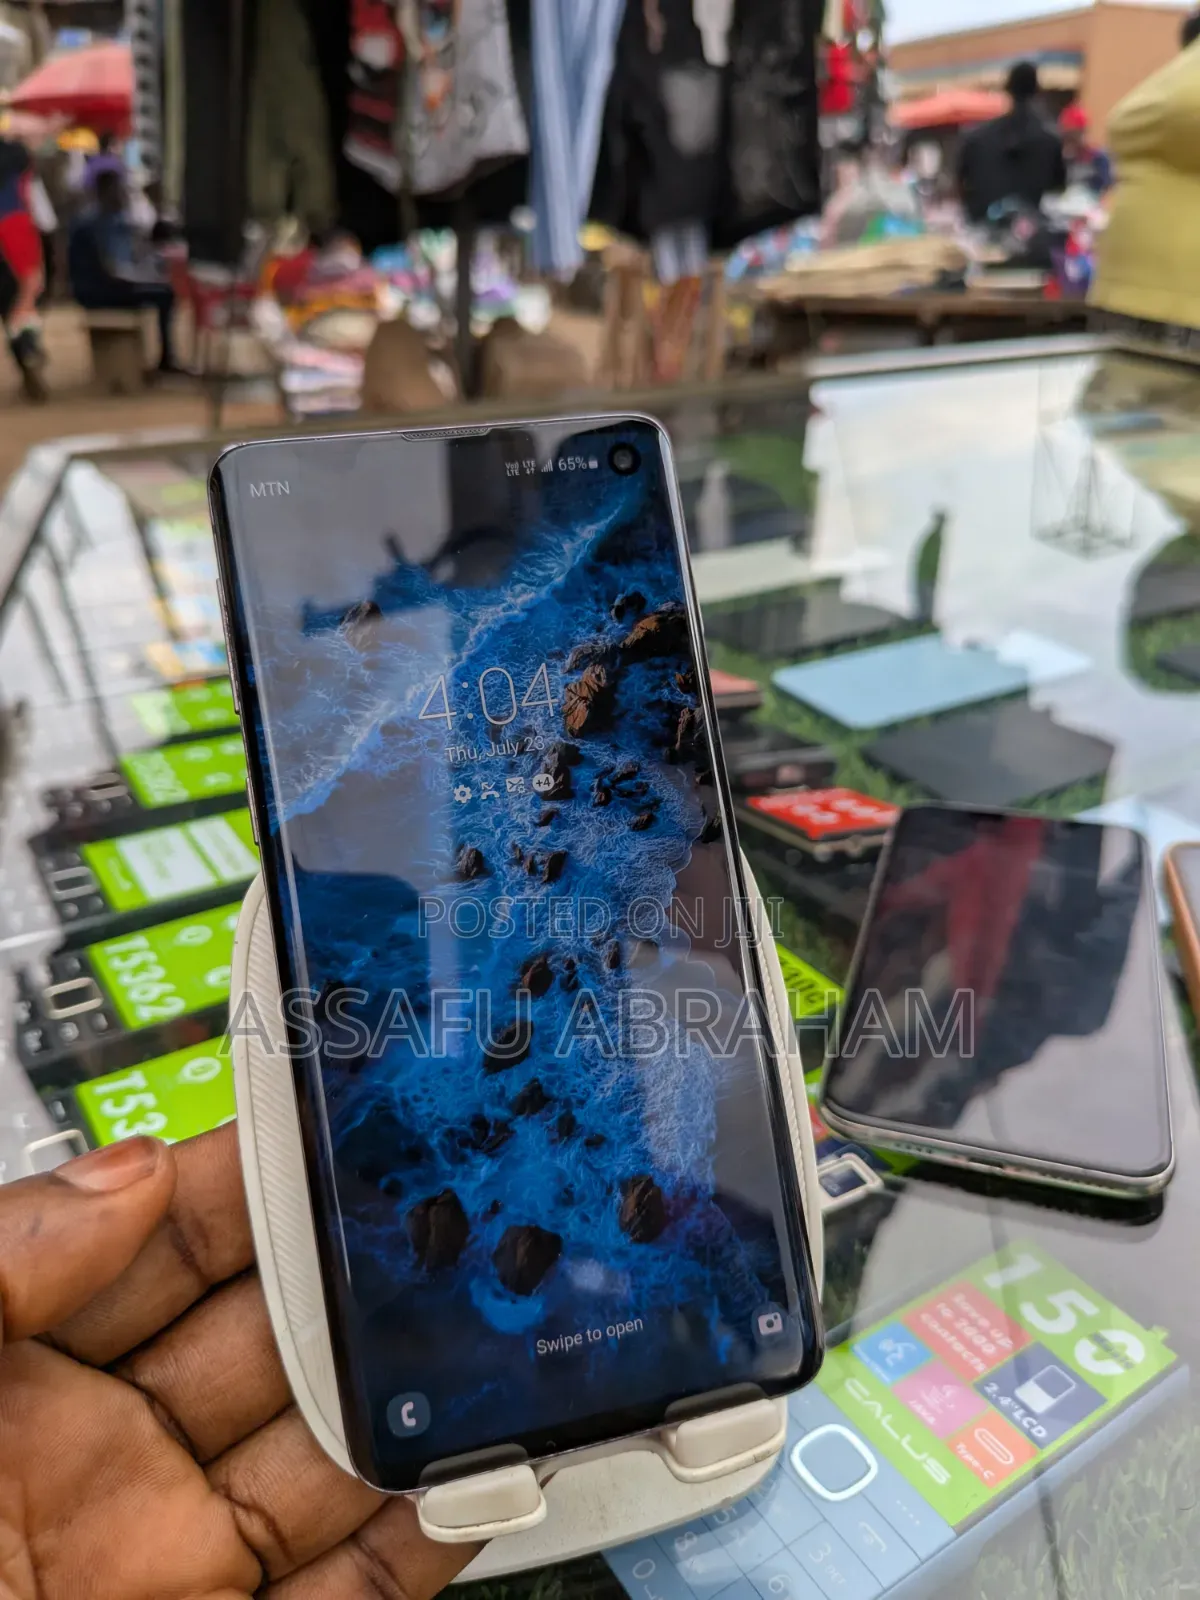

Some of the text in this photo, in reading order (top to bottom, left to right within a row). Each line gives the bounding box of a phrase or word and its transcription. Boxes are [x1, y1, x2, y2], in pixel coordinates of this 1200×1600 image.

[506, 468, 520, 476] LTE
[522, 459, 536, 468] LTE
[558, 457, 588, 471] 65%
[250, 481, 290, 498] MTN
[418, 662, 561, 730] 4:04
[445, 735, 545, 763] Thu, July 23
[535, 776, 551, 787] +4
[536, 1318, 644, 1355] Swipe to open
[844, 1377, 952, 1486] CALUS
[808, 1543, 832, 1564] 3
[767, 1573, 791, 1594] 6
